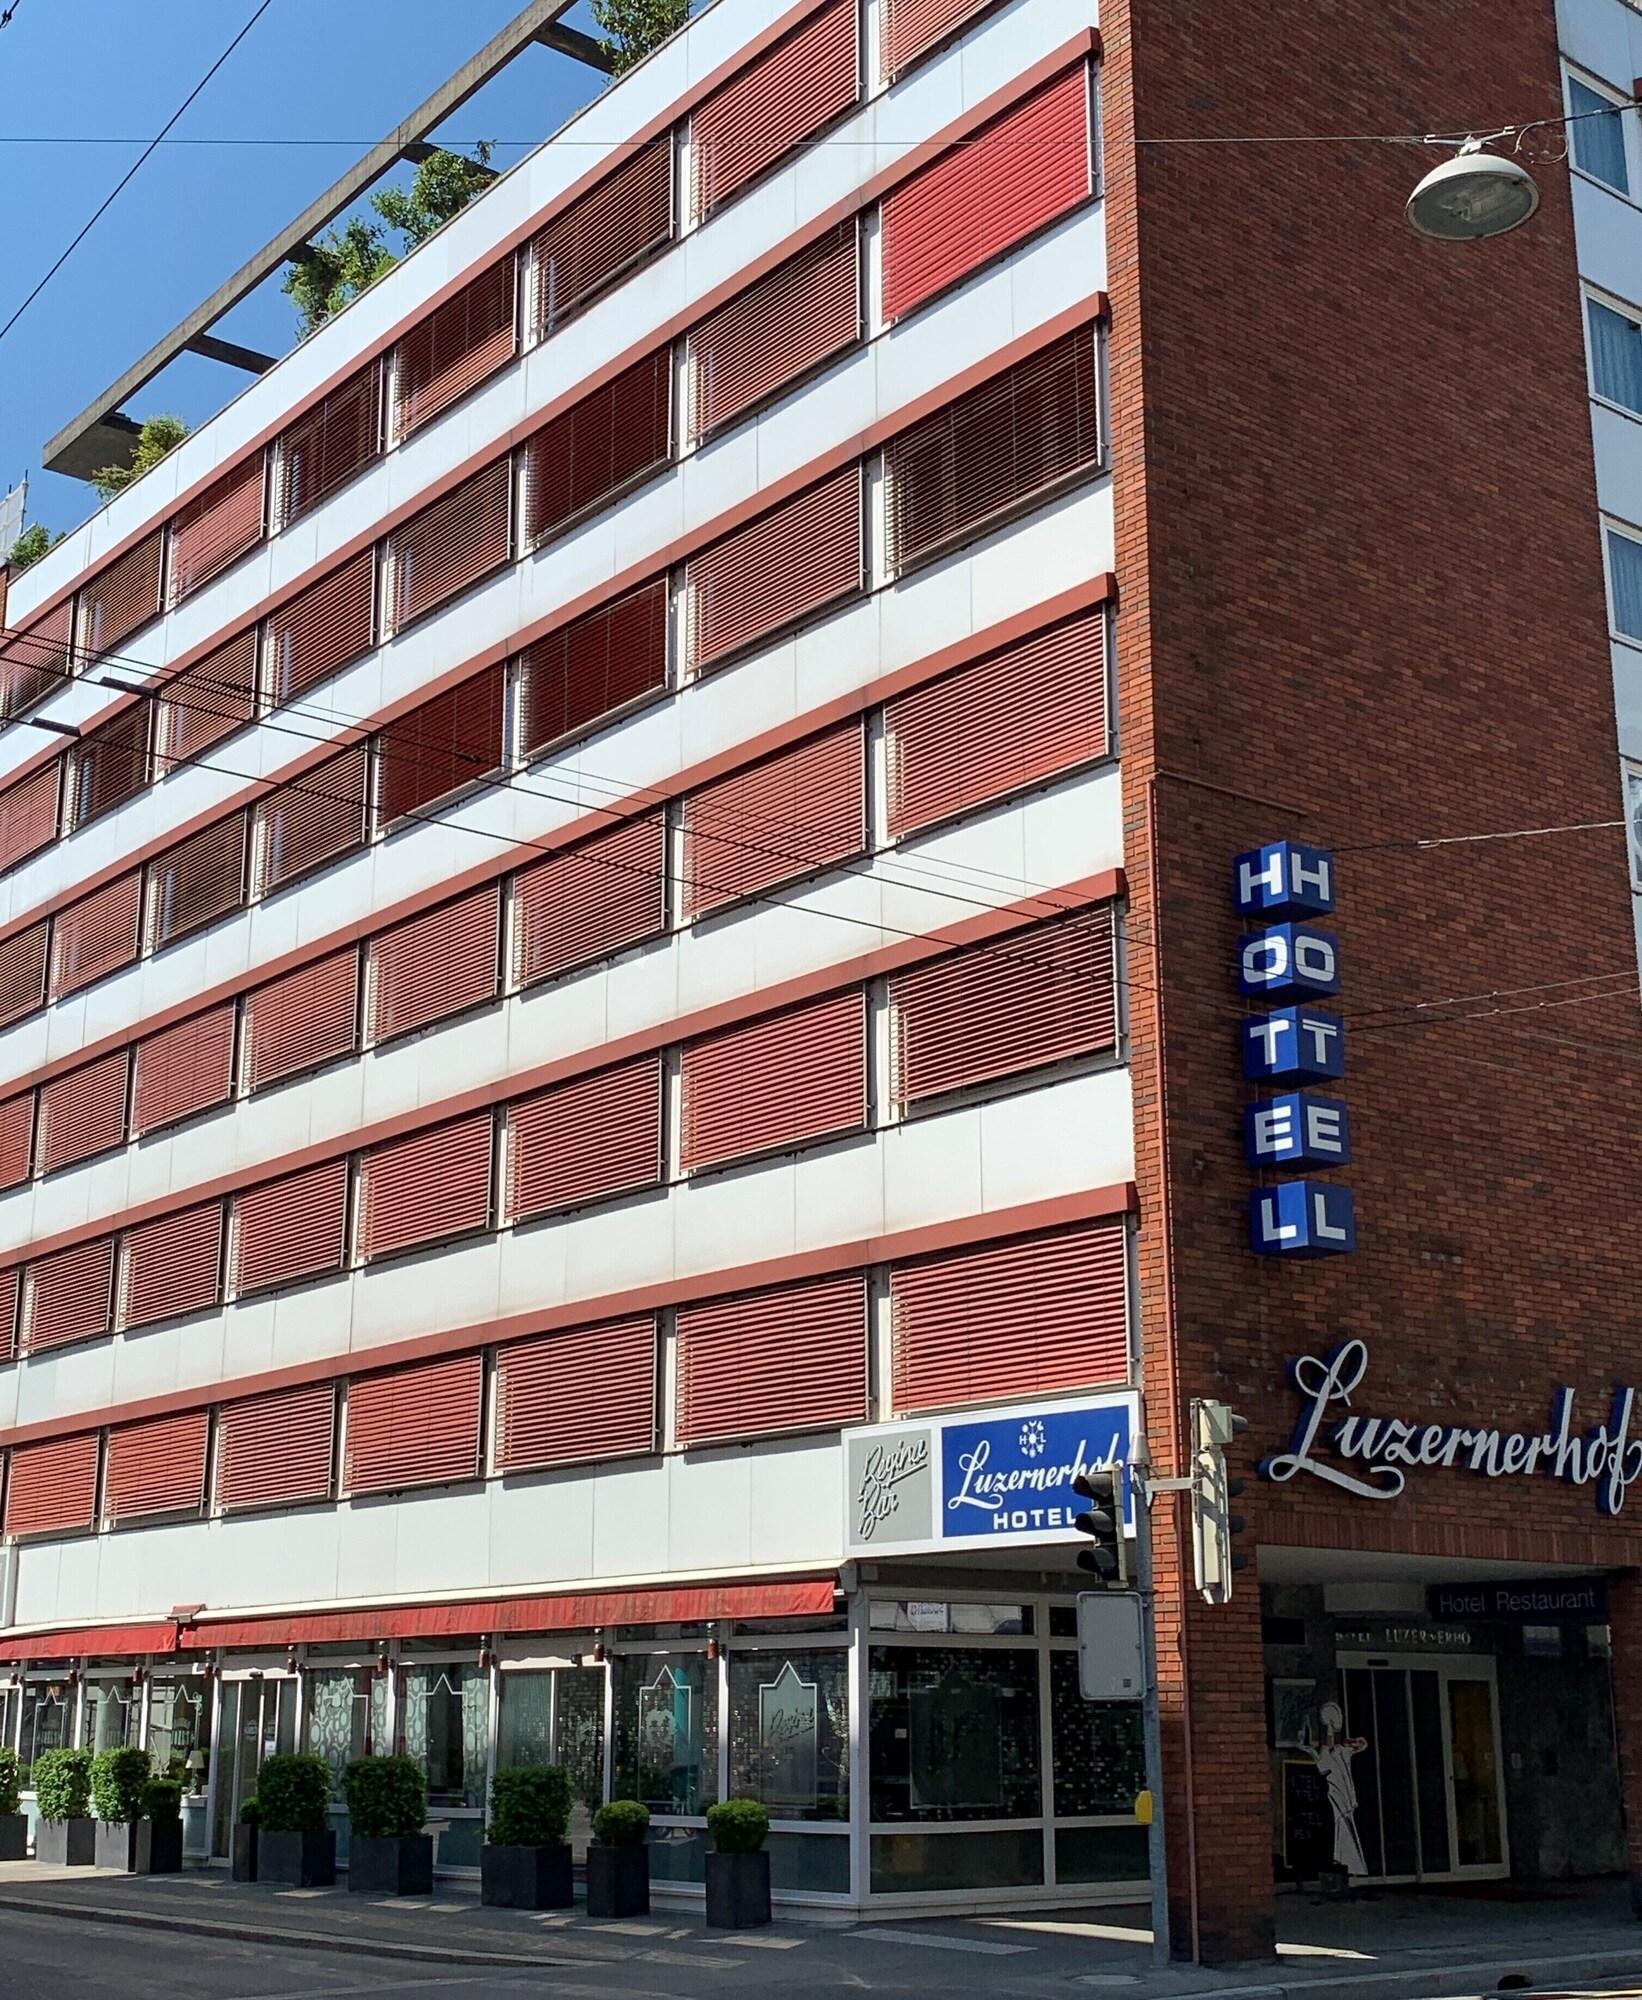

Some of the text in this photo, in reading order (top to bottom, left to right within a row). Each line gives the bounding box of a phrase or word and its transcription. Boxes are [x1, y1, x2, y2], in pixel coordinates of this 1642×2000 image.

[1239, 852, 1297, 1241] HOTEL
[1290, 852, 1346, 1241] HOTEL
[1269, 1339, 1642, 1515] Luzernerhof
[858, 1439, 928, 1494] Regina
[858, 1485, 899, 1540] Bar
[993, 1508, 1077, 1531] HOTEL
[1440, 1587, 1596, 1613] Hotel Restaurant
